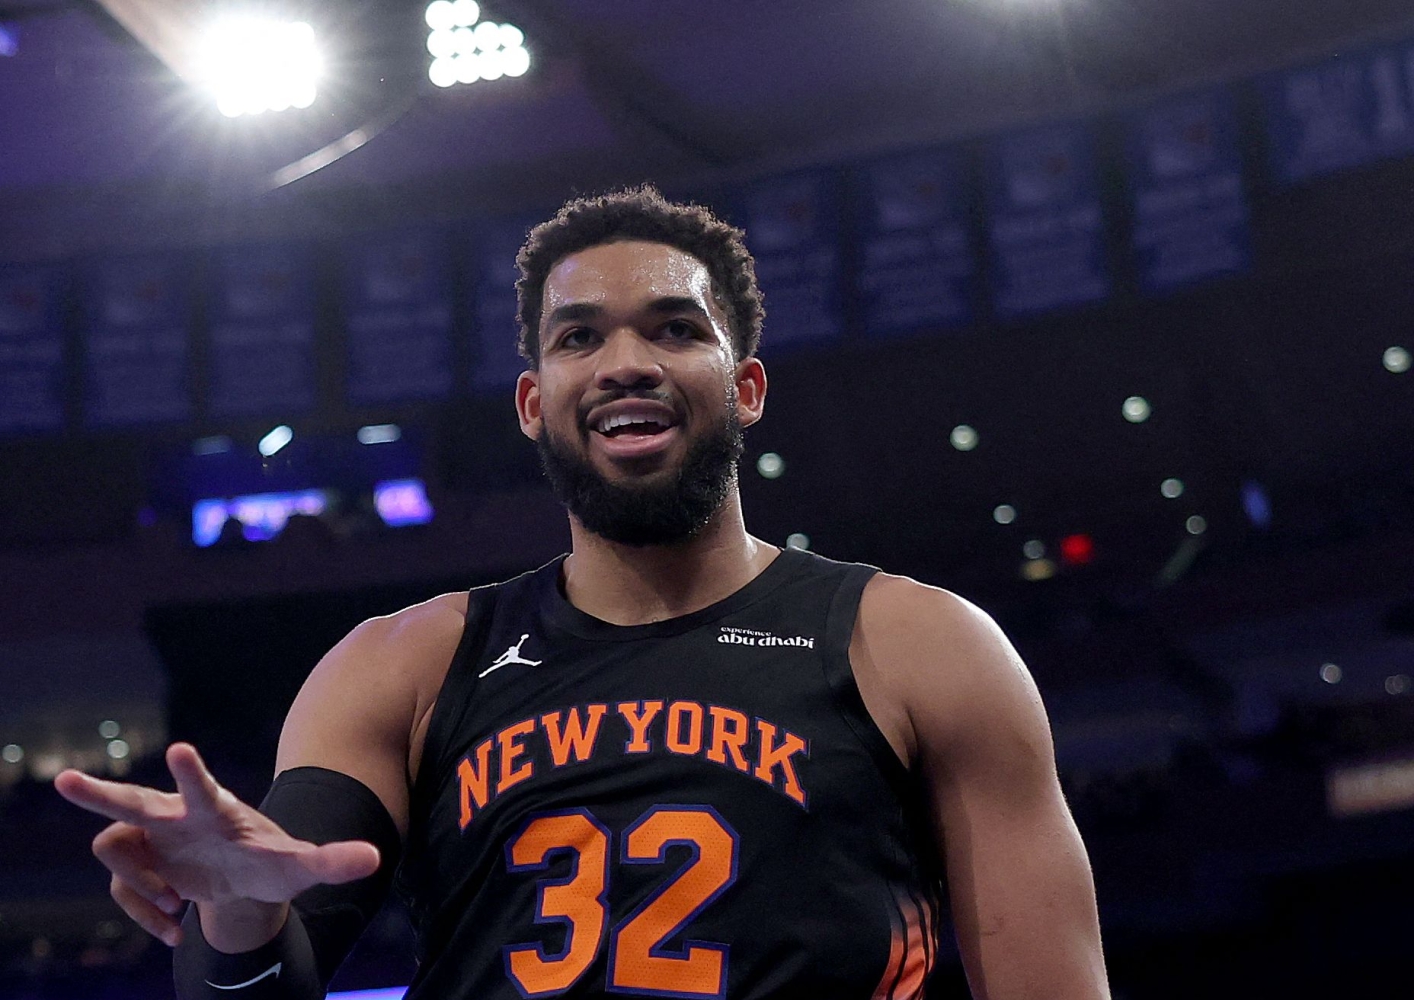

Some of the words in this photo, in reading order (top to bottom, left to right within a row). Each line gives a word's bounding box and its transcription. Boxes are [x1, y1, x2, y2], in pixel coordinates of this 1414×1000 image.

[720, 626, 772, 637] experience
[717, 633, 755, 646] abu
[757, 636, 815, 649] dhabi
[457, 703, 608, 834] NEW
[617, 700, 810, 813] YORK
